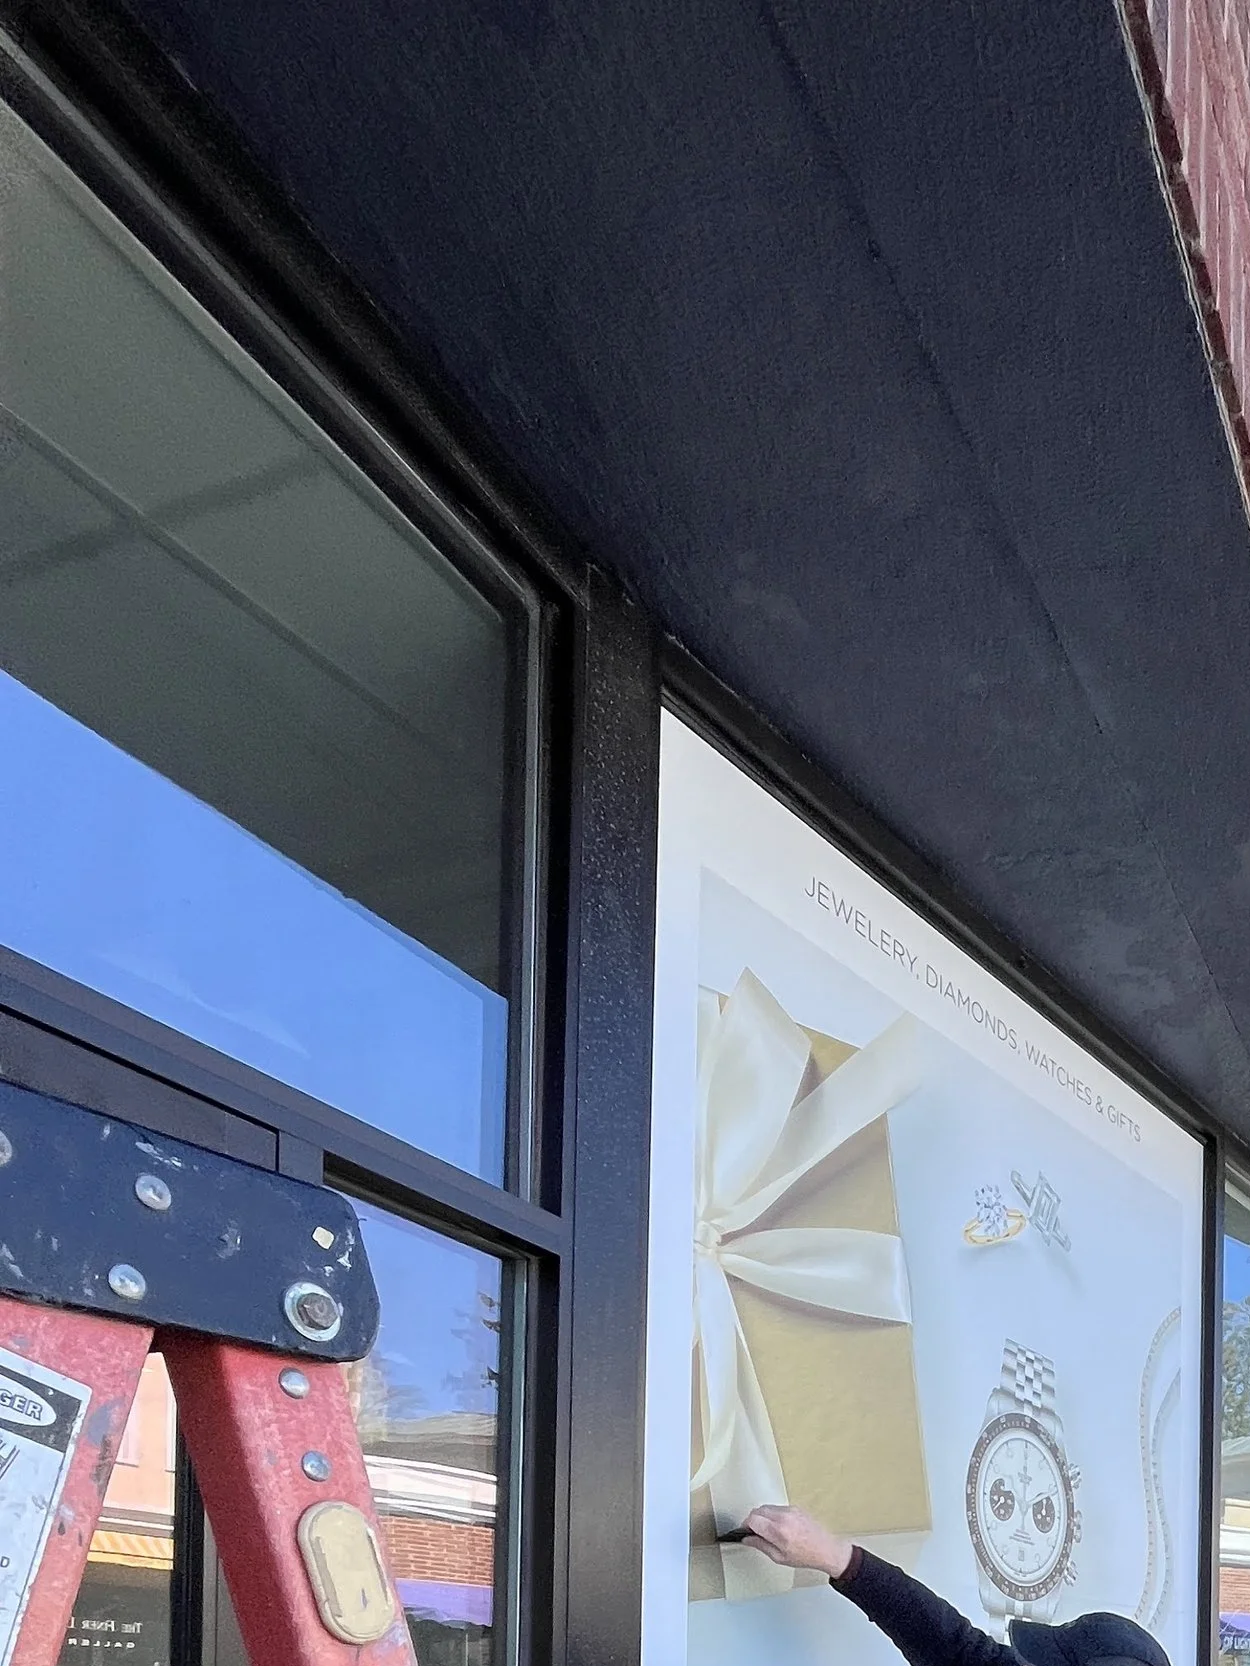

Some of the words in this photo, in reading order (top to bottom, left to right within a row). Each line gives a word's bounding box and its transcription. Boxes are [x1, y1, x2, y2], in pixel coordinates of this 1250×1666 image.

[803, 875, 920, 981] JEWELERY,
[924, 963, 1021, 1056] DIAMONDS,
[1025, 1039, 1093, 1107] WATCHES
[1095, 1095, 1105, 1115] &
[1107, 1105, 1142, 1143] GIFTS
